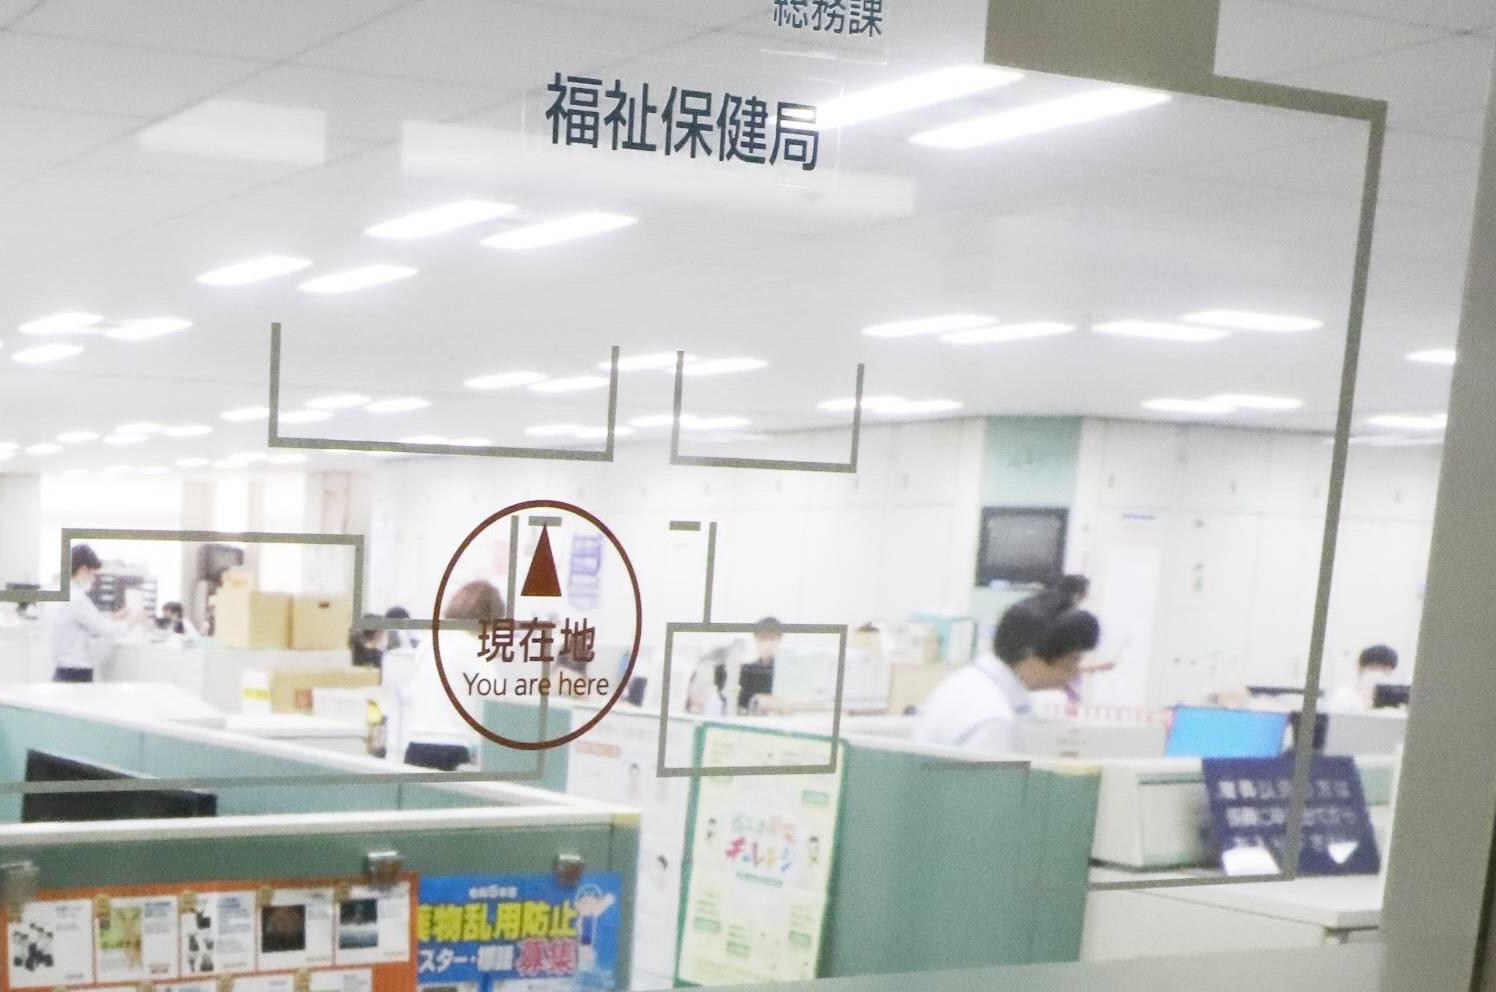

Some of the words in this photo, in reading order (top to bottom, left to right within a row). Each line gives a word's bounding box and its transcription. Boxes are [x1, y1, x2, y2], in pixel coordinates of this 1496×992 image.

[773, 0, 882, 37] 総務課
[544, 72, 819, 171] 福祉保健局
[477, 617, 596, 664] 現在地
[462, 672, 507, 697] You
[515, 677, 551, 697] are
[559, 672, 609, 697] here
